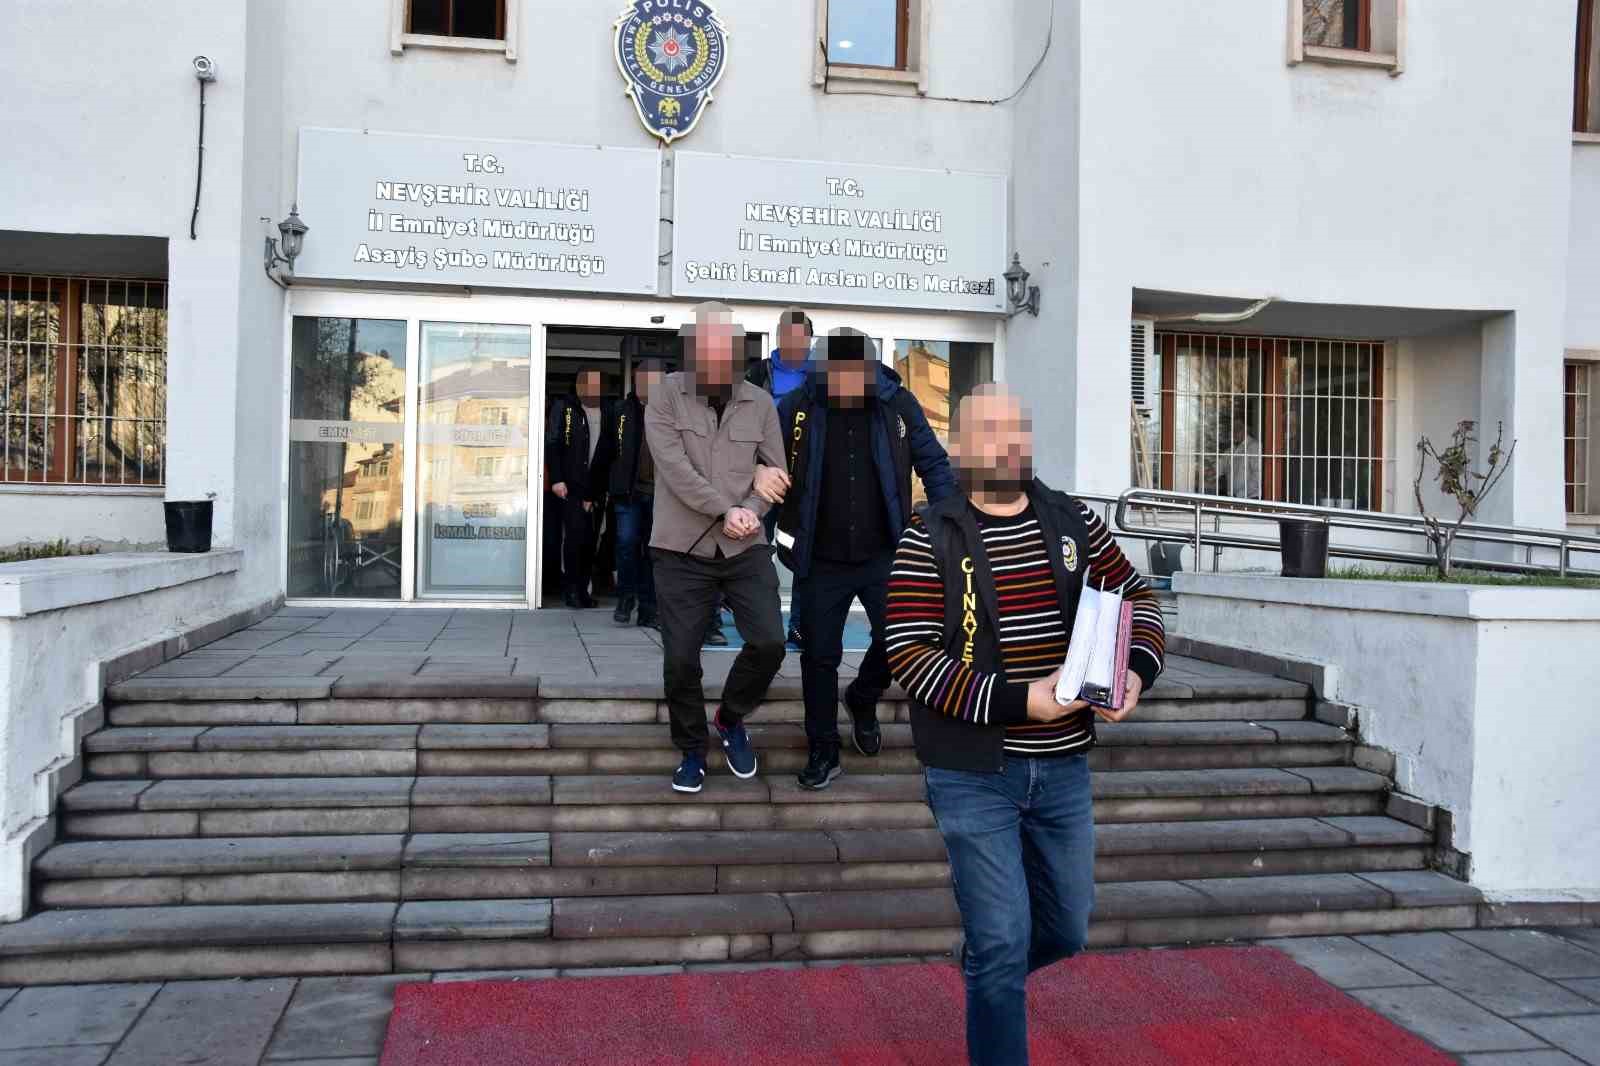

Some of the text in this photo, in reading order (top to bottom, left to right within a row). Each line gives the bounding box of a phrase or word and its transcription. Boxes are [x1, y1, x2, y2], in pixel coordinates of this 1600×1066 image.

[463, 153, 505, 174] T.C.
[375, 182, 589, 212] NEVŞEHİR VALİLİĞİ
[826, 176, 865, 198] T.C.
[368, 208, 595, 245] İl Emniyet Müdürlüğü
[745, 202, 942, 232] NEVŞEHİR VALİLİĞİ
[354, 244, 605, 277] Asayiş Şube Müdürlüğü
[738, 228, 948, 264] İl Emniyet Müdürlüğü
[685, 261, 995, 296] Şehit İsmail Arslan Polis Merkezi
